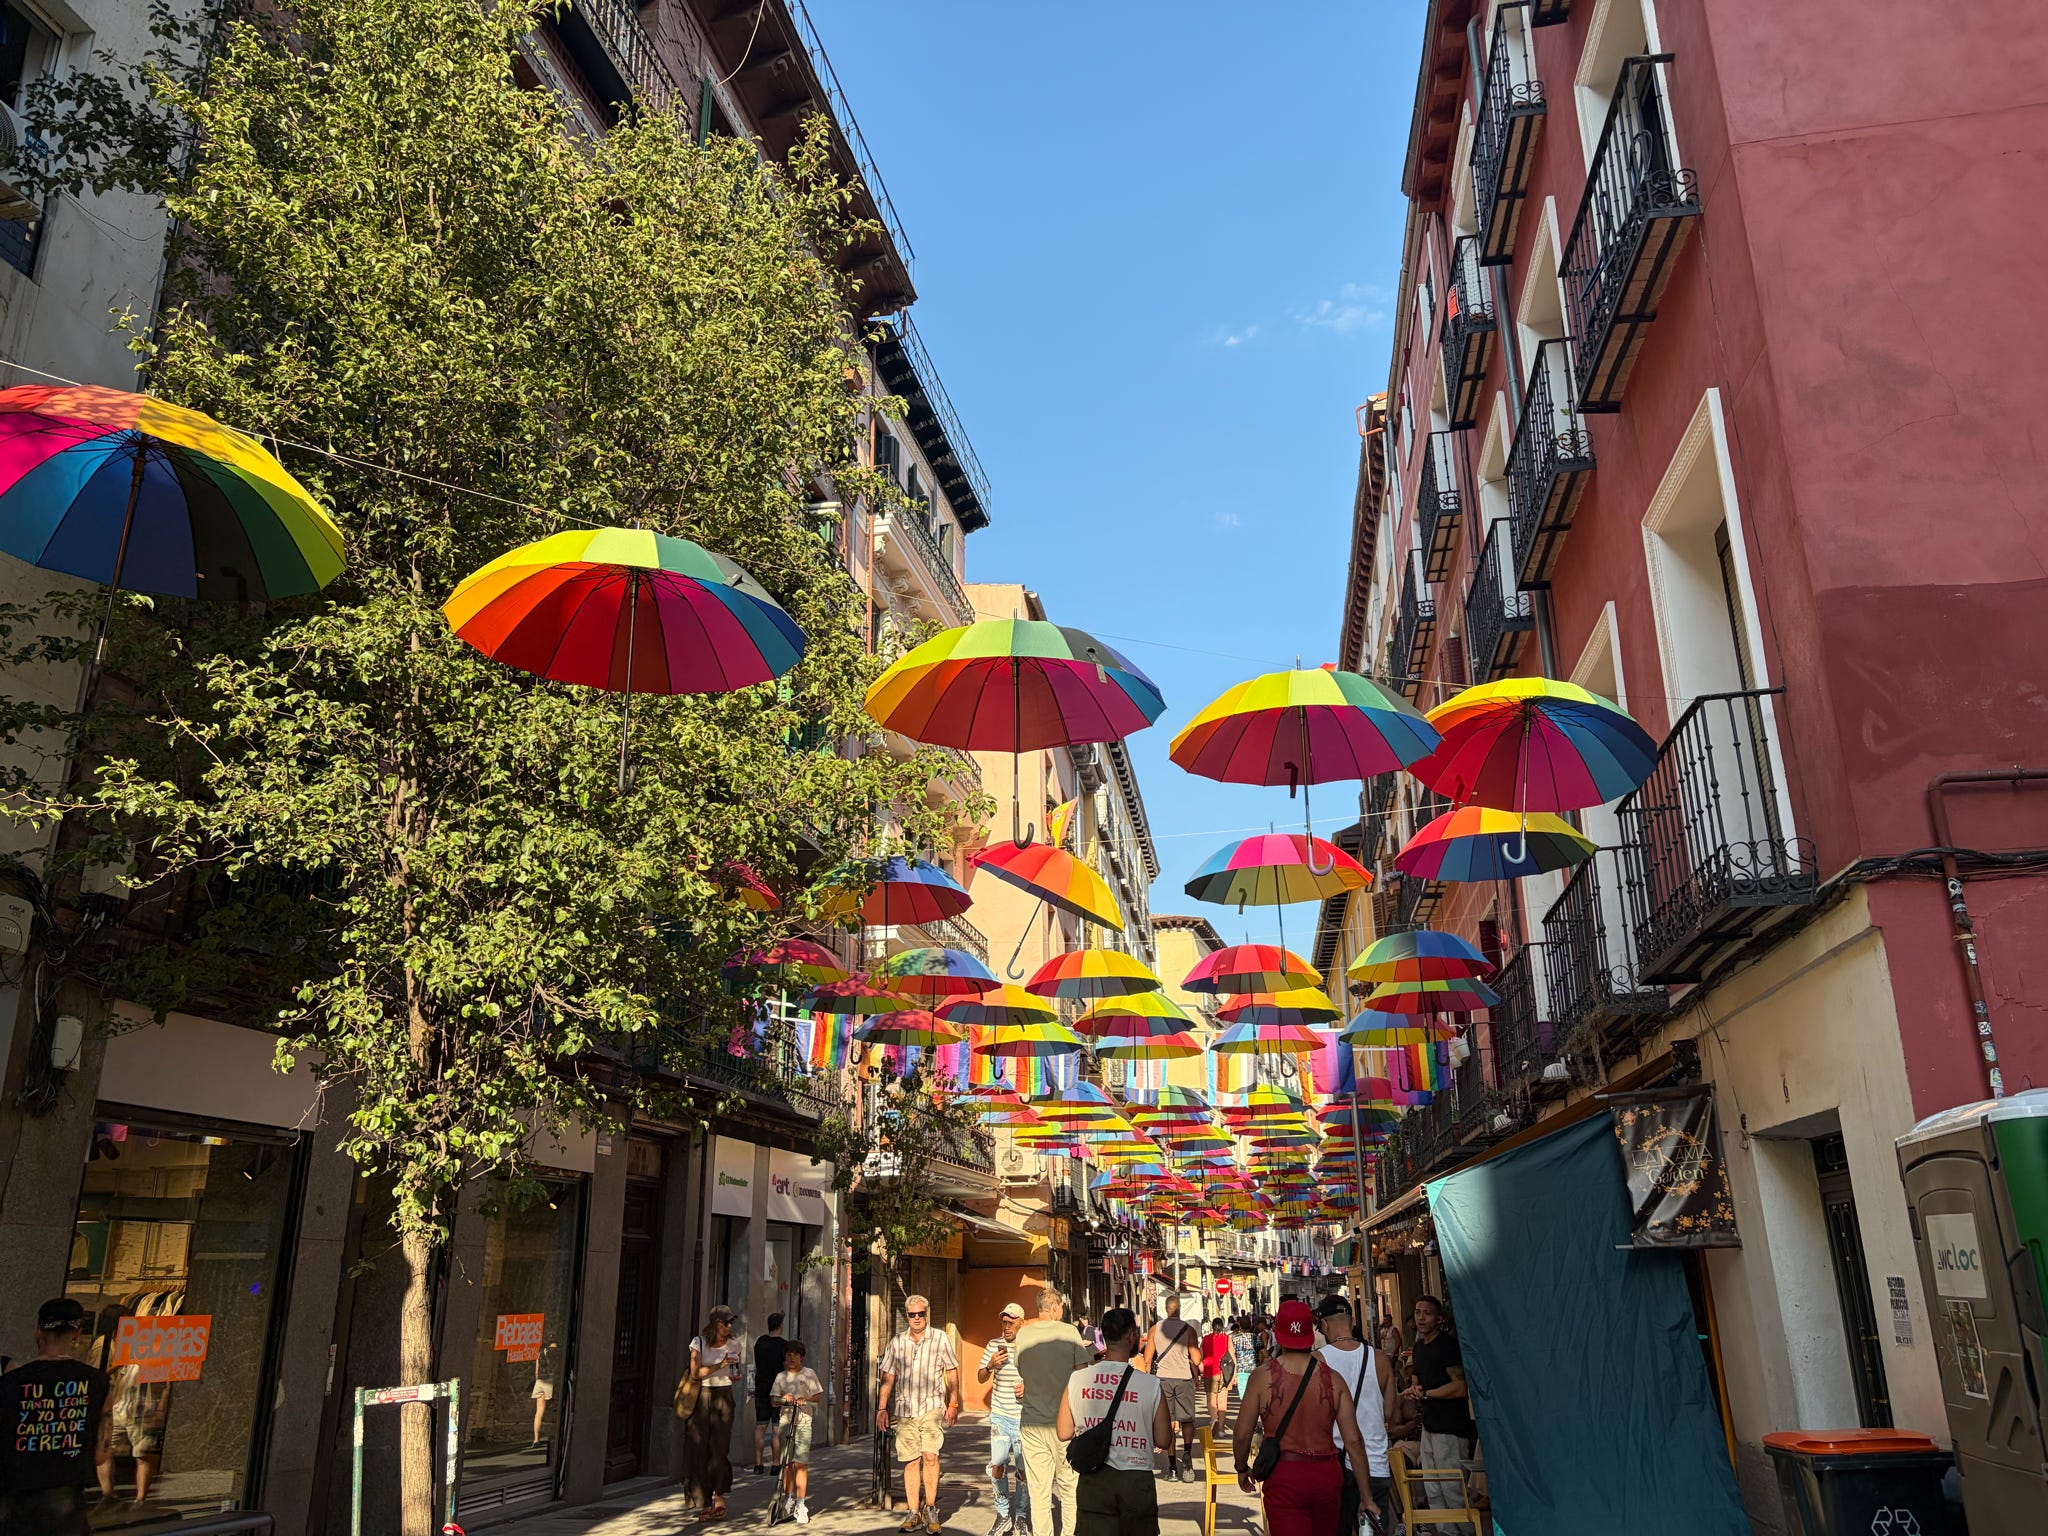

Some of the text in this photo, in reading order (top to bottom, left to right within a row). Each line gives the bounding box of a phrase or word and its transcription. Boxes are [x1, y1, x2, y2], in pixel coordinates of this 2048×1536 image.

[1648, 1166, 1705, 1185] Garden
[115, 1317, 207, 1368] Rebajas
[495, 1315, 542, 1351] Rebajas
[21, 1380, 89, 1399] TU CON
[20, 1395, 89, 1411] TANTA LECHE
[19, 1406, 87, 1423] Y YO CON
[17, 1419, 87, 1436] CARITA DE
[15, 1433, 83, 1452] CEREAL
